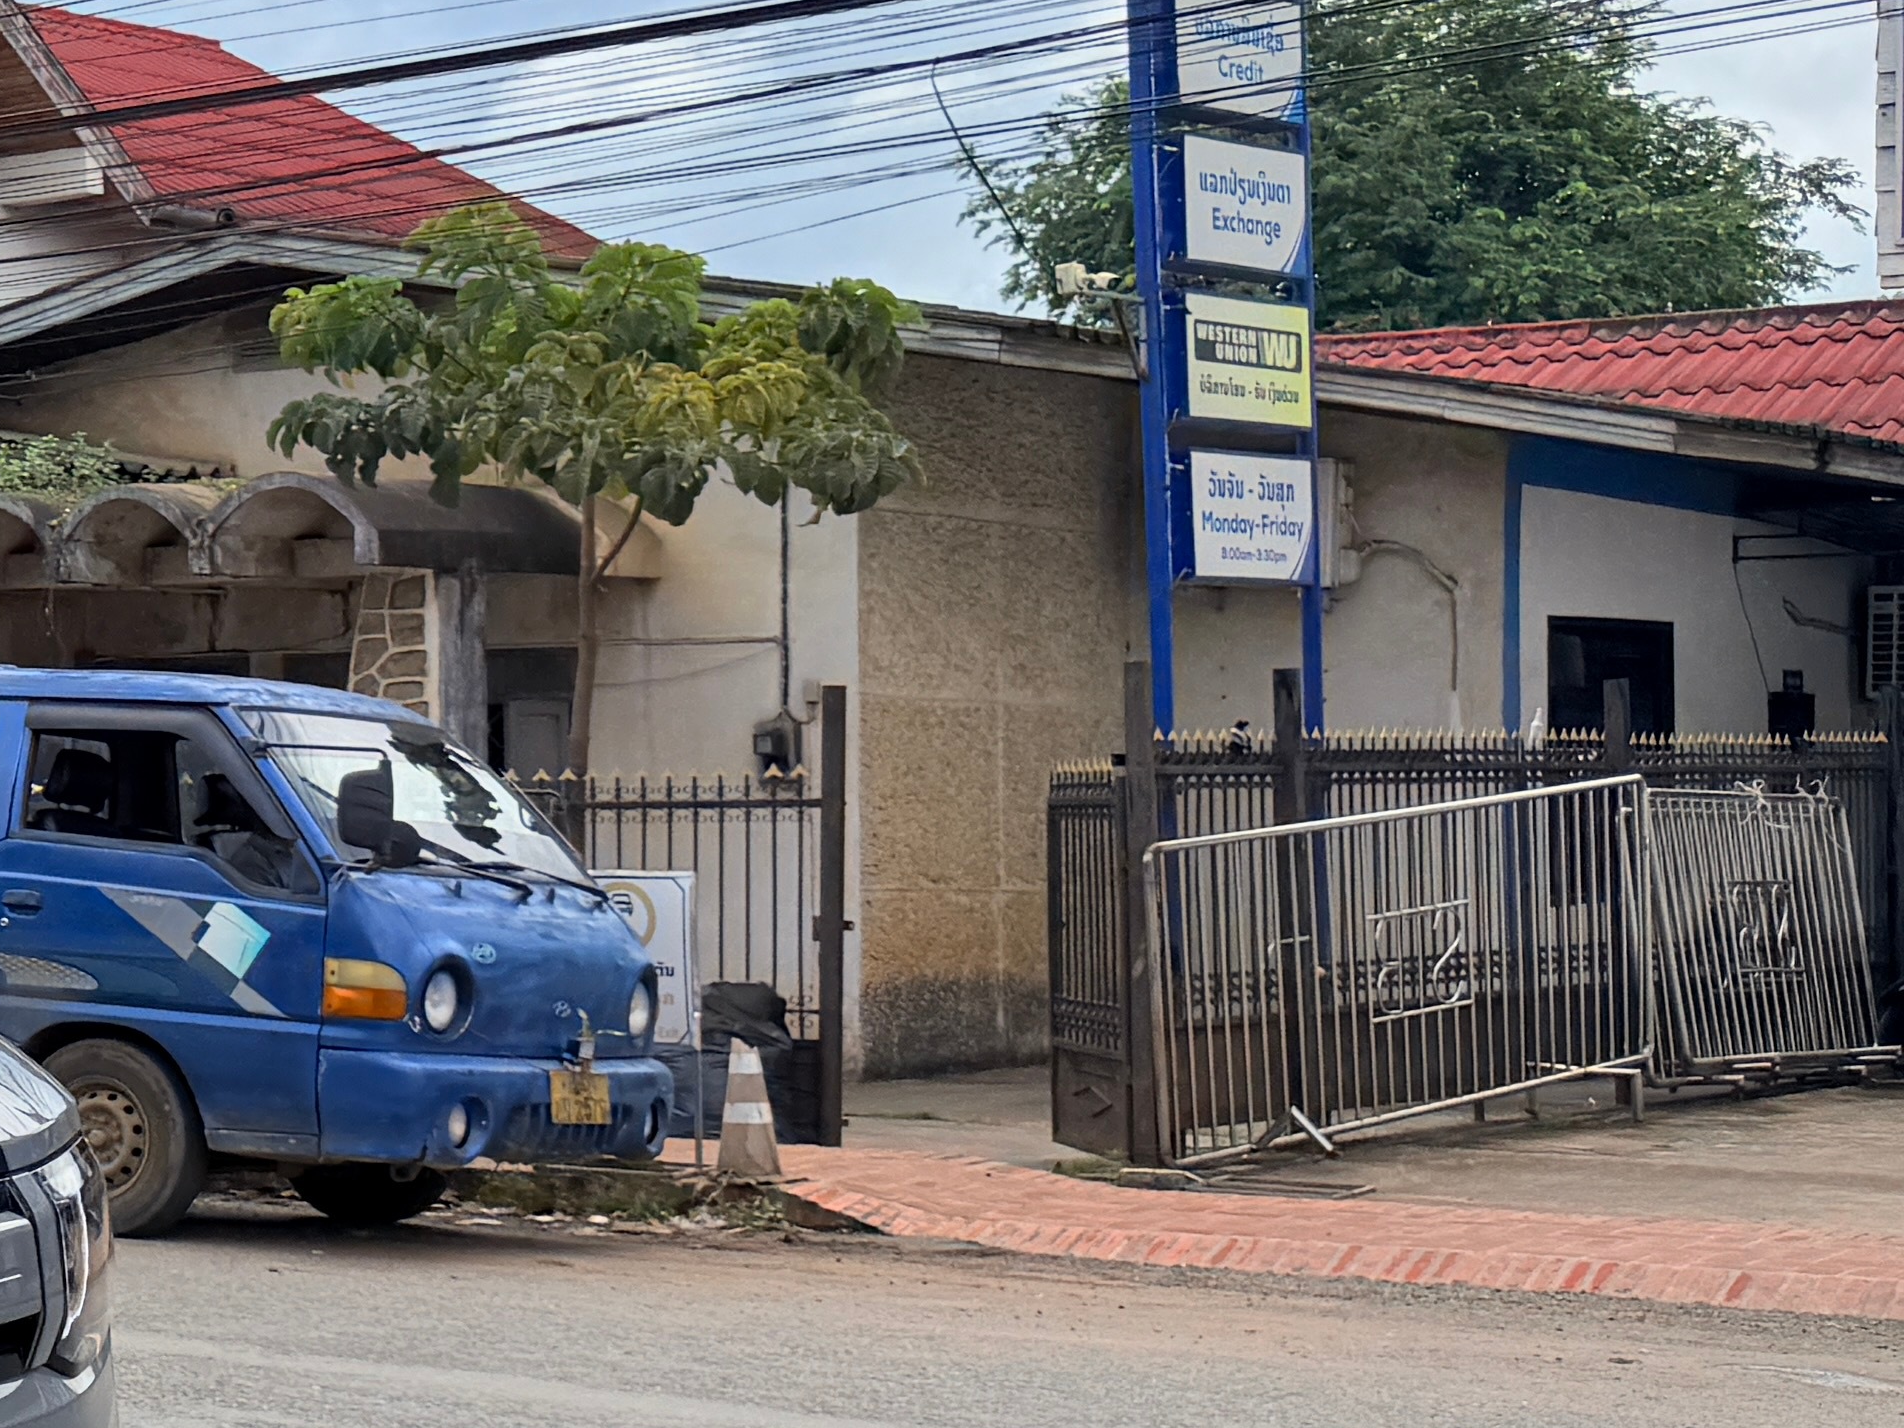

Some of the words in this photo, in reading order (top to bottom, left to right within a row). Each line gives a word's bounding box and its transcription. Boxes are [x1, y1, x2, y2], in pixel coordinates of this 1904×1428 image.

[1218, 54, 1264, 82] Credit
[1212, 207, 1281, 245] Exchange
[1196, 323, 1257, 346] WESTERN
[1262, 332, 1297, 369] WU
[1215, 343, 1258, 364] UNION
[1208, 470, 1244, 499] ວັນຈັນ
[1258, 473, 1295, 512] ວັນສຸກ
[1202, 510, 1304, 543] Monday-Friday
